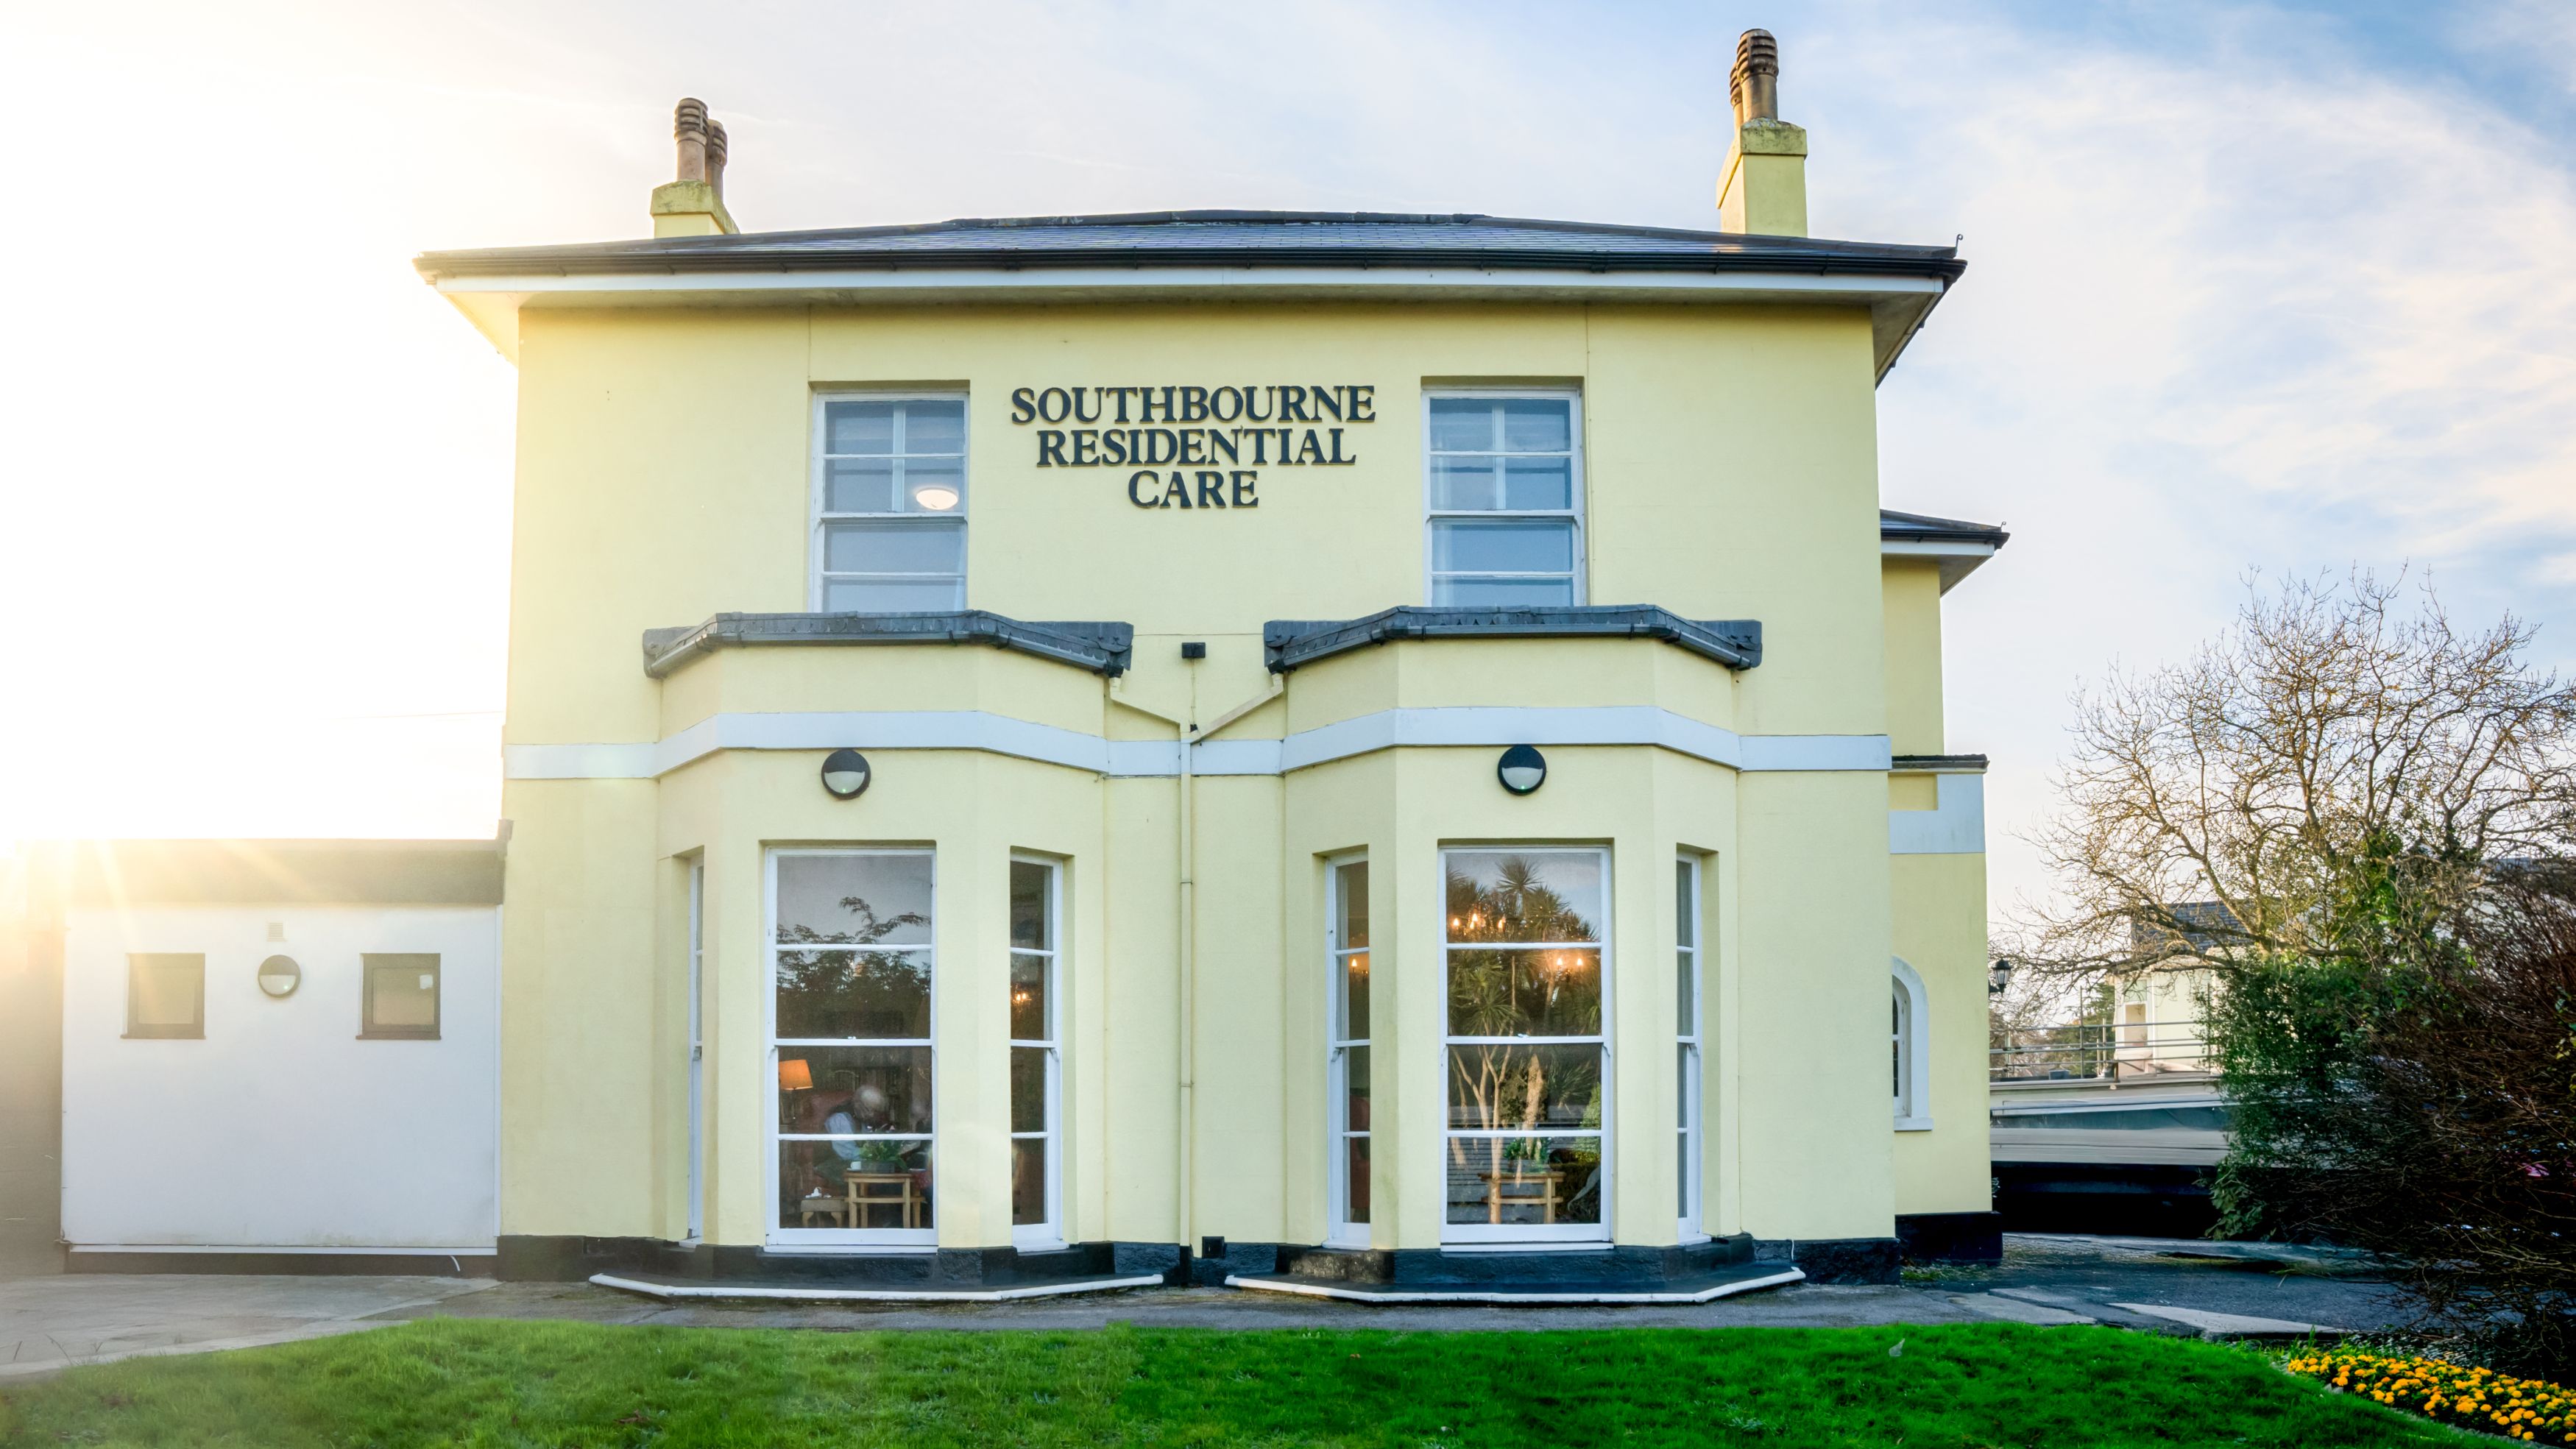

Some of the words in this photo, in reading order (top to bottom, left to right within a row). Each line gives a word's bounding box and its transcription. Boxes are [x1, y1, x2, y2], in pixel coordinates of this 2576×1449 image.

[1011, 386, 1376, 424] SOUTHBOURNE
[1036, 428, 1356, 467] RESIDENTIAL
[1128, 470, 1259, 509] CARE
